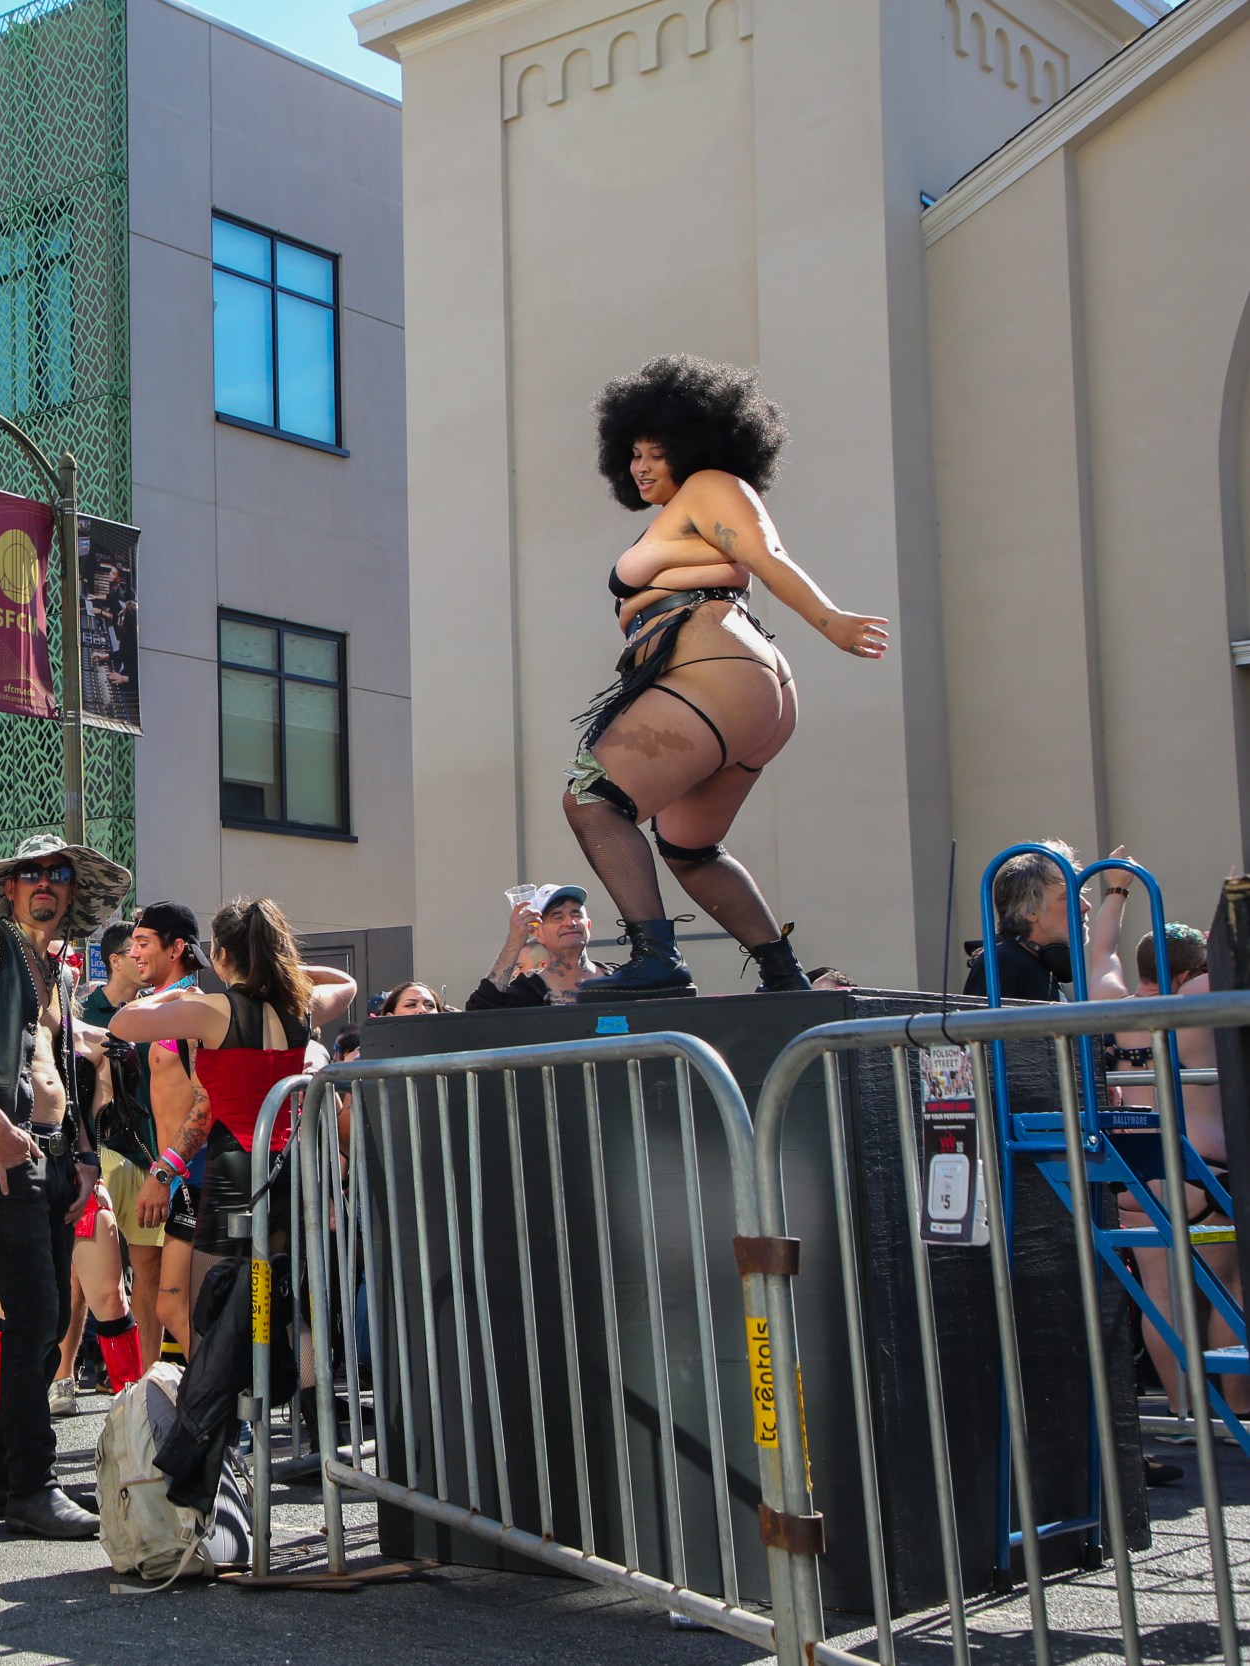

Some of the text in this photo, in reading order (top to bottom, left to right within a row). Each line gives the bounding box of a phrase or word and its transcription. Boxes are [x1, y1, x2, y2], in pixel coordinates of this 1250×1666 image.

[90, 968, 108, 978] Plate
[934, 1059, 959, 1069] STREET
[931, 1113, 943, 1121] YOUR
[1112, 1115, 1148, 1125] BALLYMORE
[760, 1422, 777, 1442] tc
